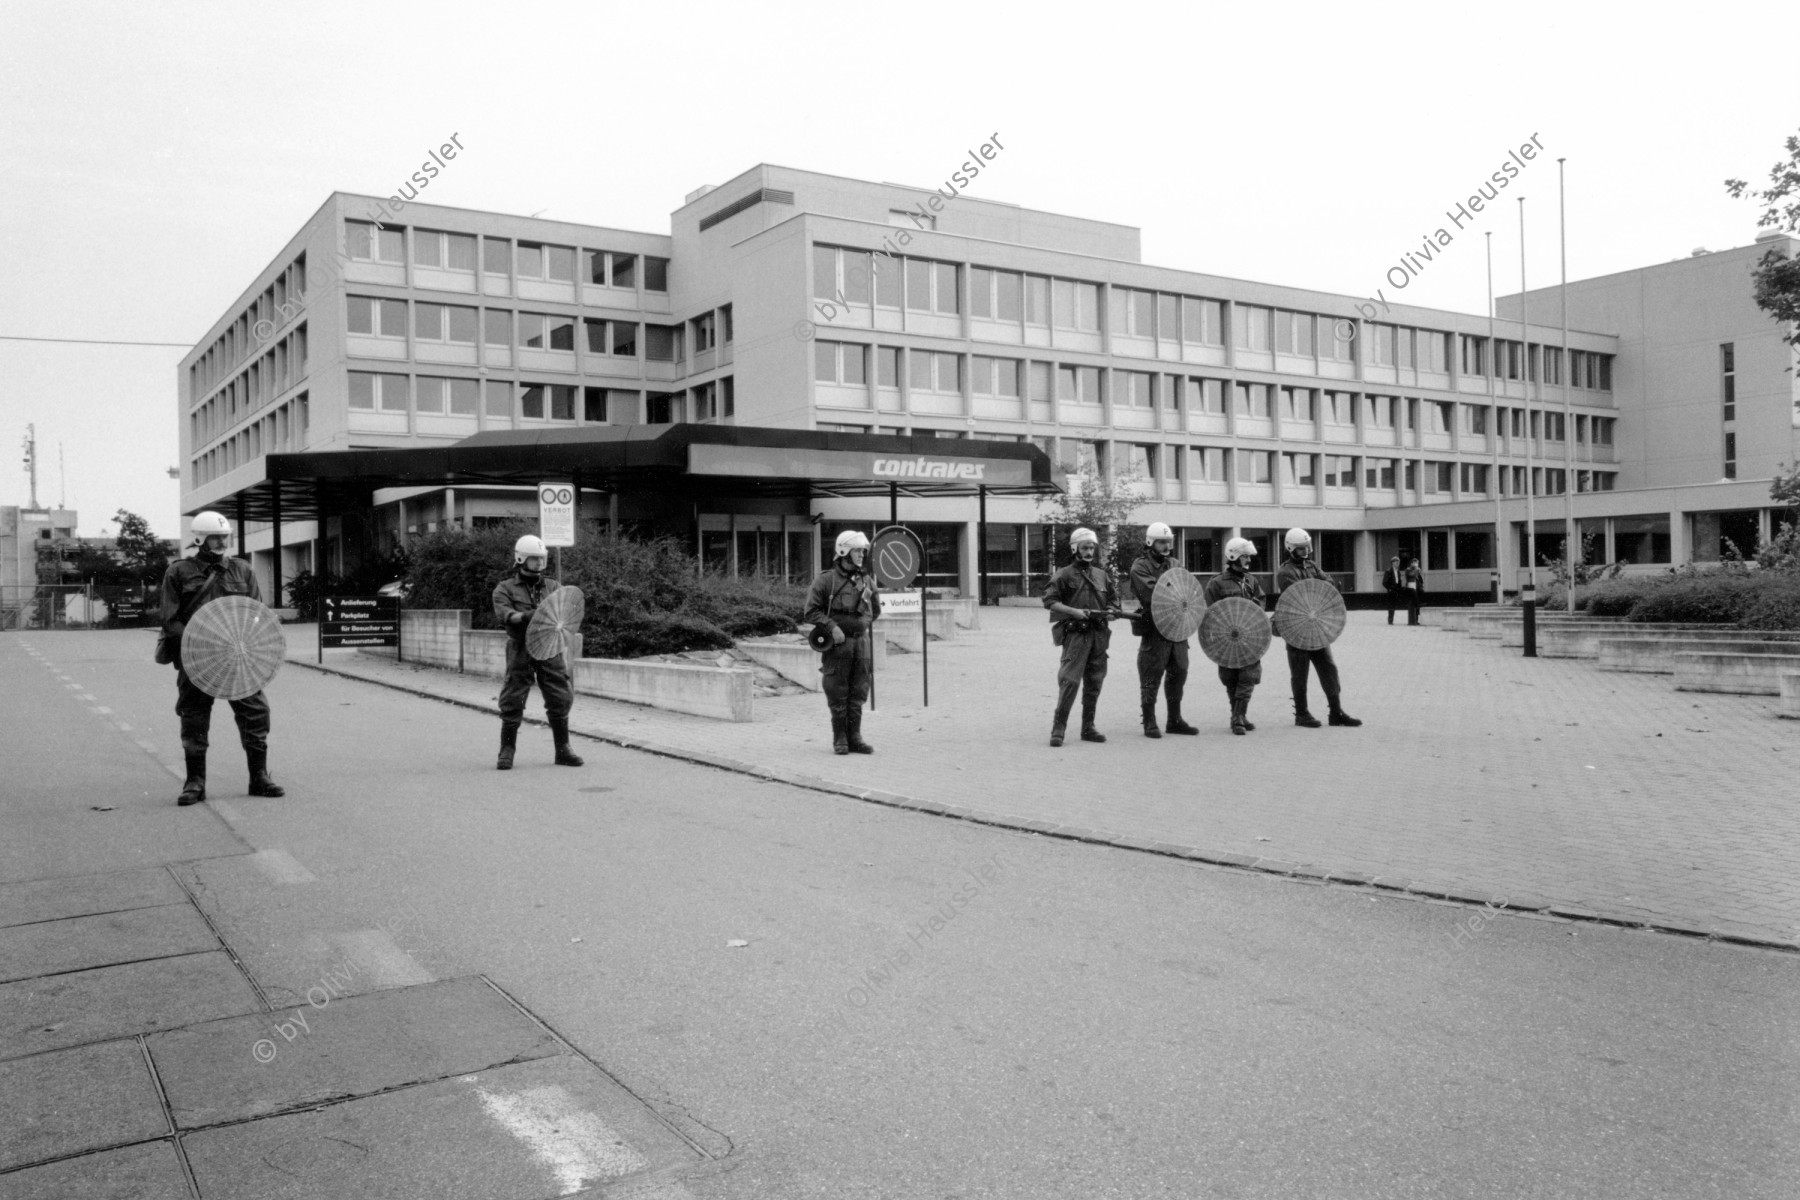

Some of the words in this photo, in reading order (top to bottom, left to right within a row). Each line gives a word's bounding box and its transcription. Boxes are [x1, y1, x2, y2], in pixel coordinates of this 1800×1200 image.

[872, 457, 985, 479] contraves
[340, 599, 377, 607] Anlieferung
[341, 624, 350, 632] für
[351, 624, 380, 632] Besucher
